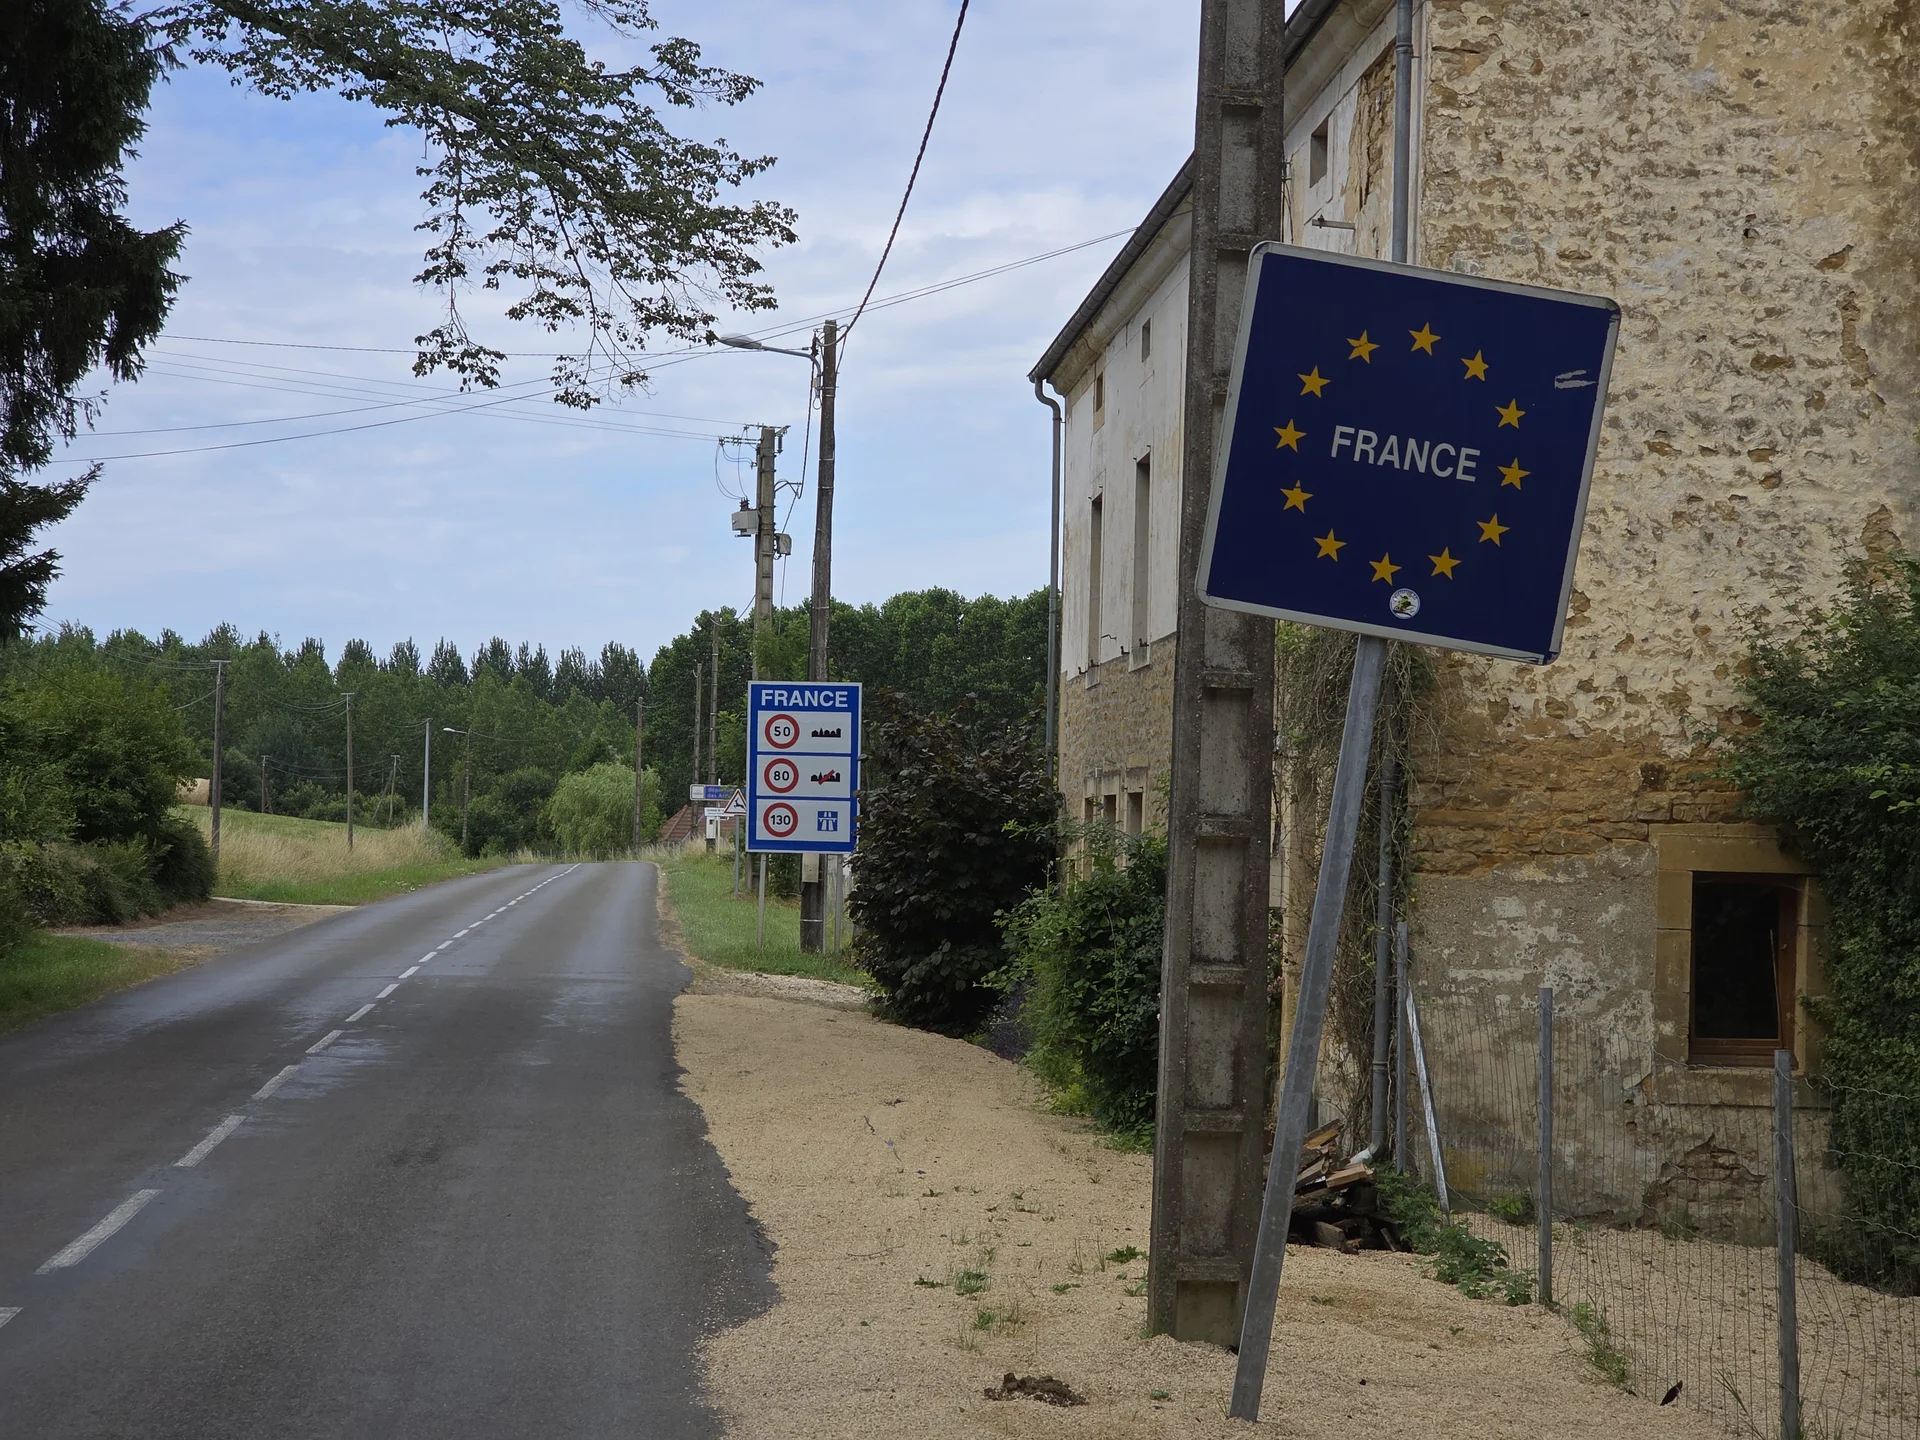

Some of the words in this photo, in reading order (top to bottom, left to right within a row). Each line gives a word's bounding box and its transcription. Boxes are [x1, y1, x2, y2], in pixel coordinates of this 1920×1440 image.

[1331, 425, 1481, 482] FRANCE
[761, 690, 848, 708] FRANCE
[773, 726, 791, 737] 50
[773, 770, 790, 781] 80
[770, 815, 791, 826] 130
